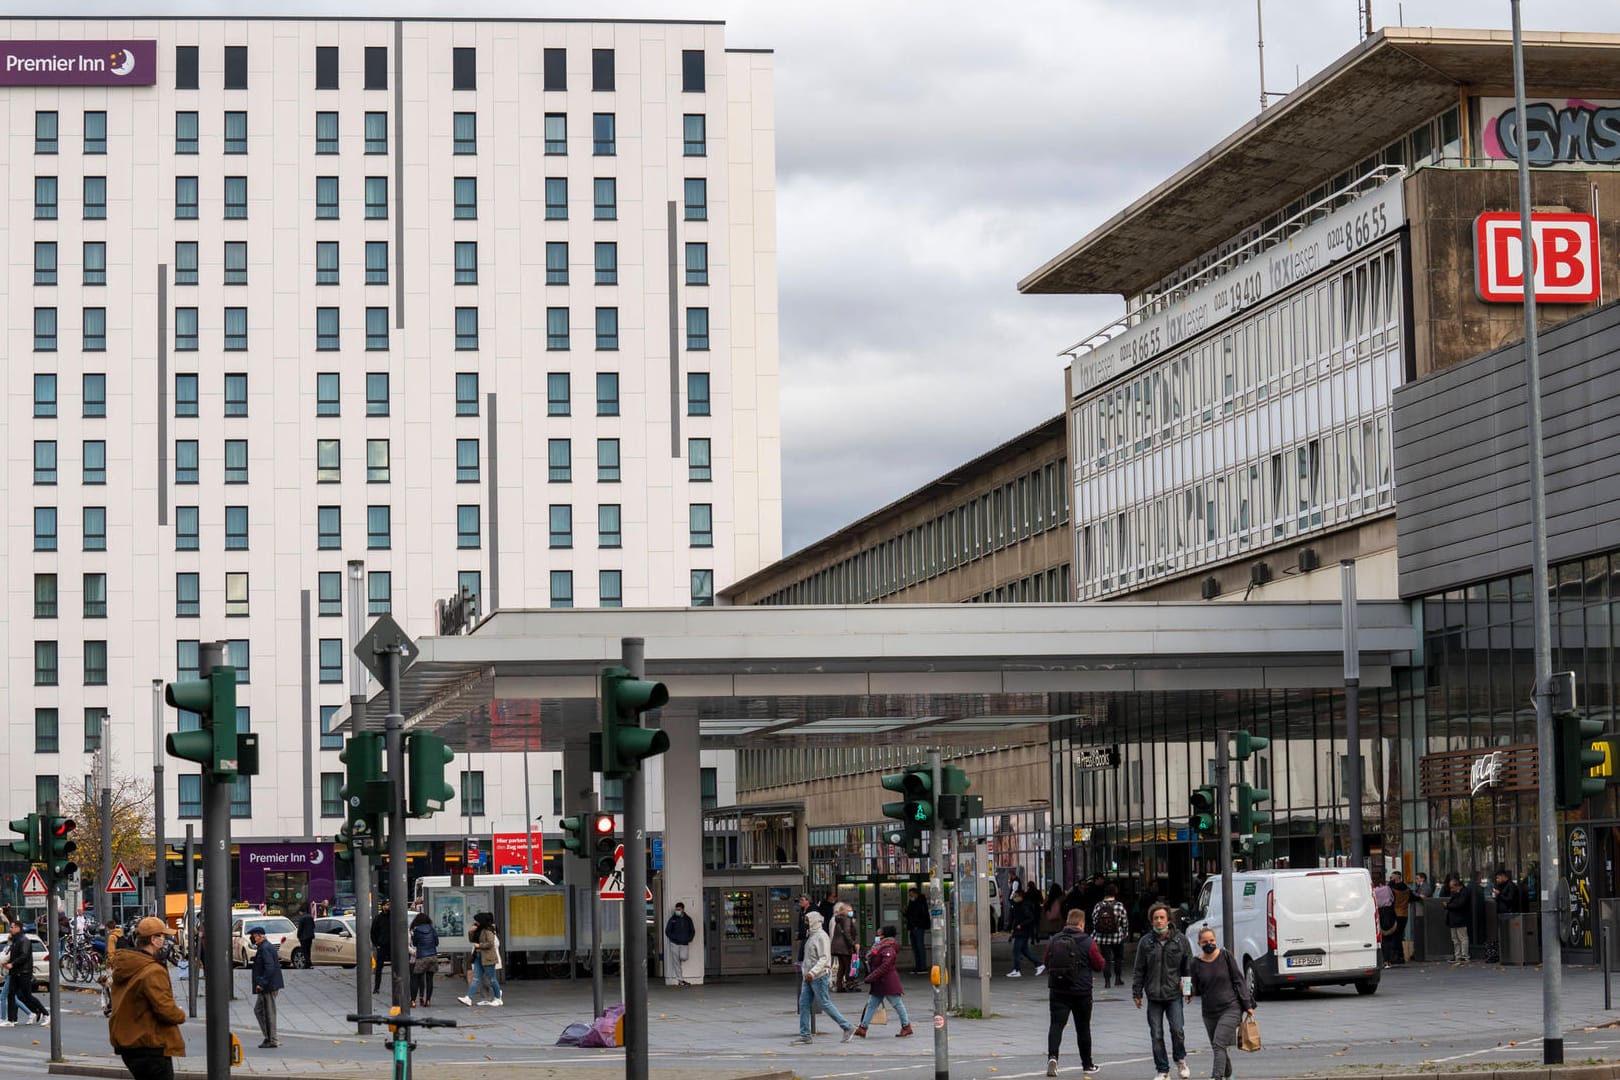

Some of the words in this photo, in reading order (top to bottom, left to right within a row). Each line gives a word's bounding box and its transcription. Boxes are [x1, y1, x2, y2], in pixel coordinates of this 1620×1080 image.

[6, 55, 76, 71] Premier
[79, 55, 105, 71] Inn
[1214, 289, 1228, 311] 0201
[1327, 226, 1344, 251] 0201
[1494, 227, 1585, 287] DB
[250, 853, 288, 863] Premier
[291, 853, 306, 863] Inn
